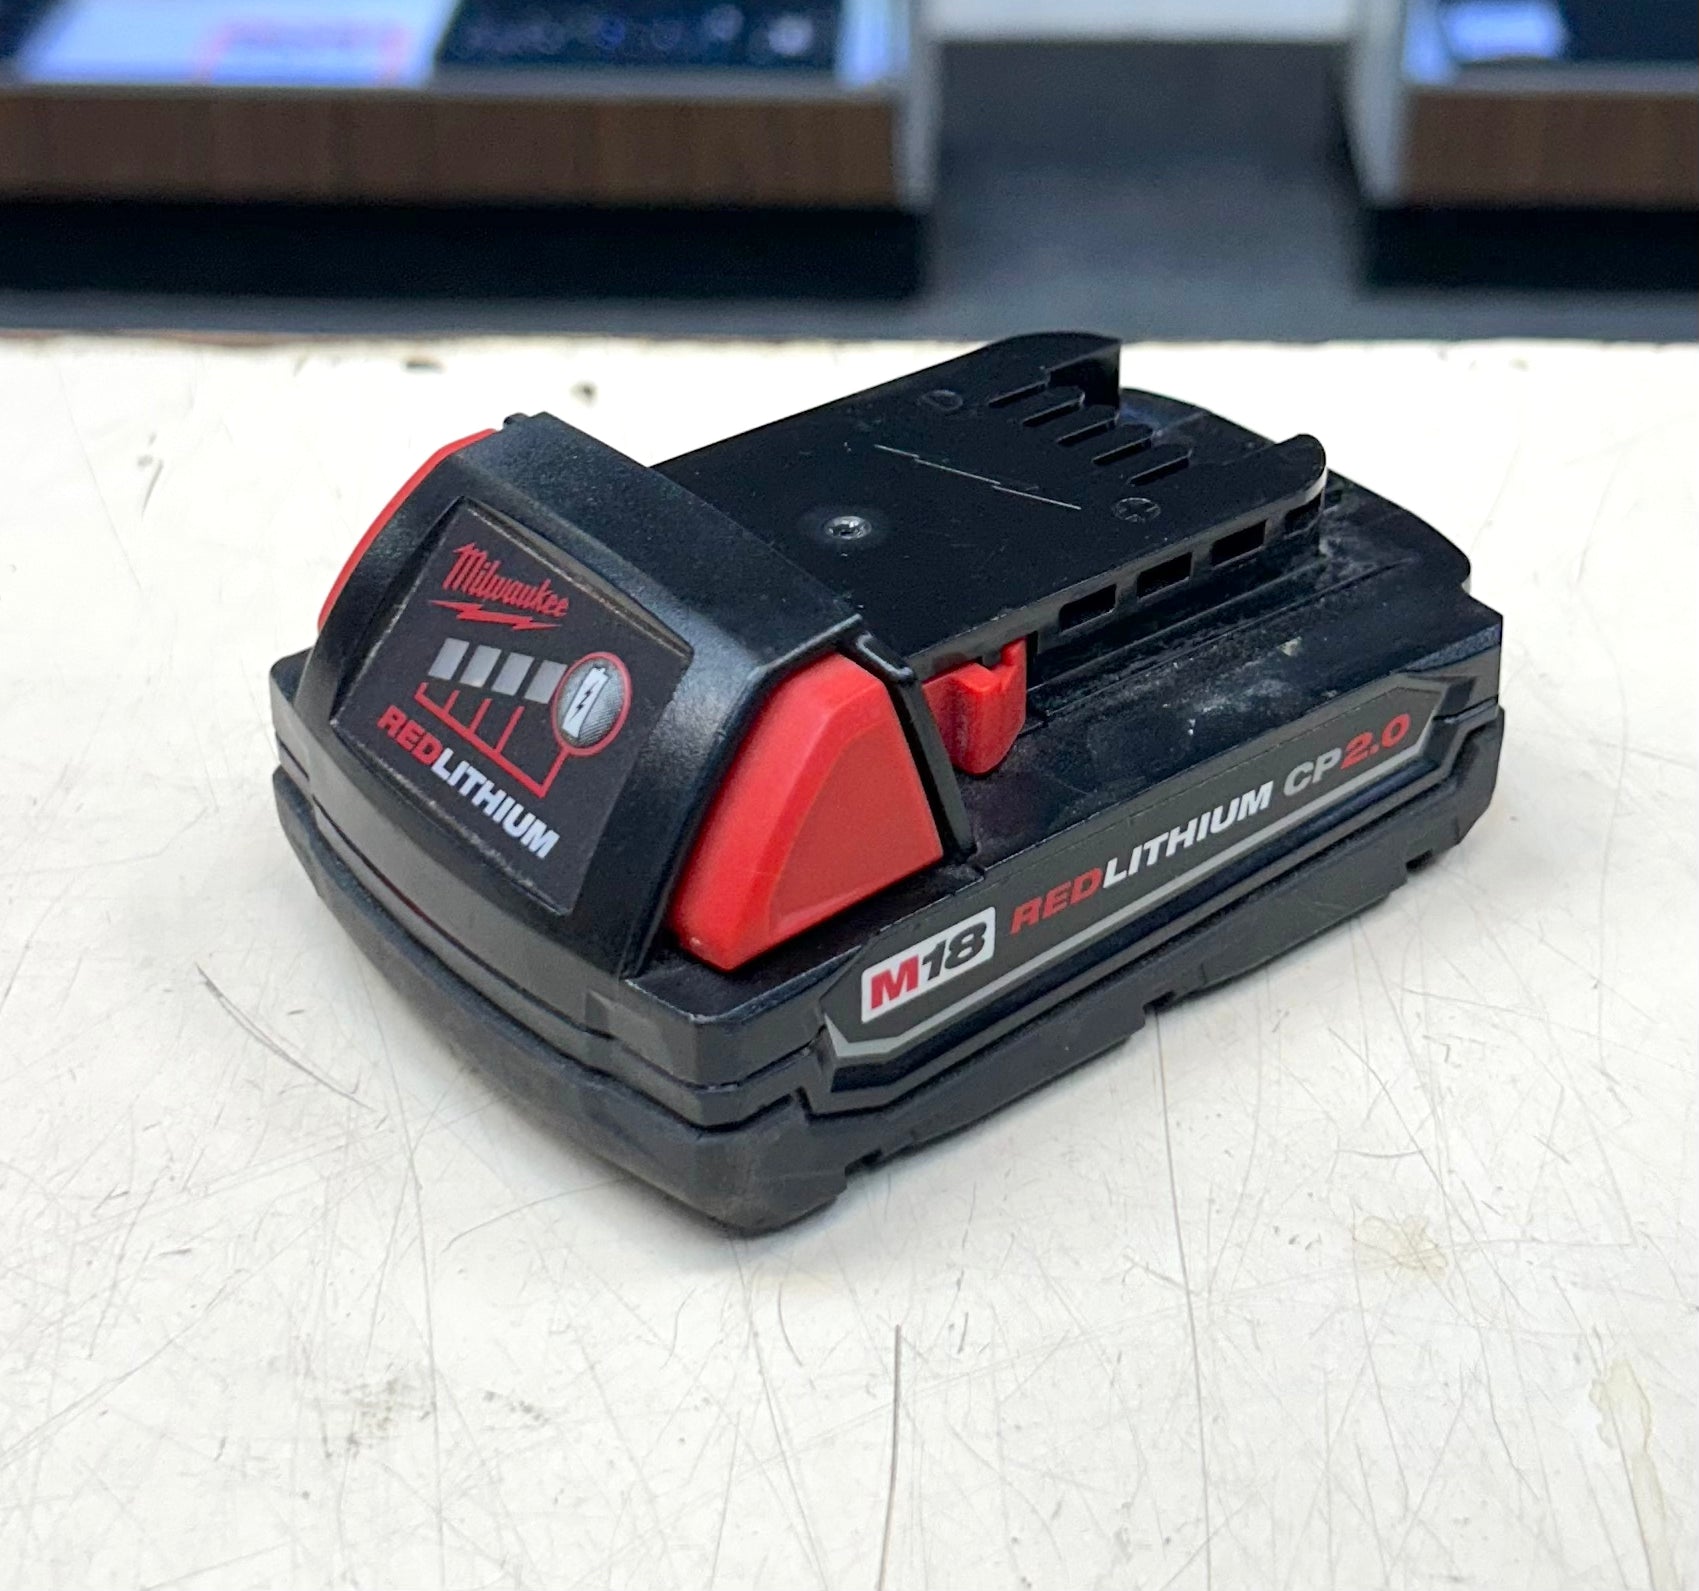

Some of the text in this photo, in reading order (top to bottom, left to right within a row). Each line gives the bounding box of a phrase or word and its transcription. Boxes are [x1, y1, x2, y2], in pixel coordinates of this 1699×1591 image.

[442, 543, 569, 617] Milwaukee
[377, 705, 560, 859] REDLITHIUM
[870, 714, 1411, 1009] M18 REDLITHIUM CP2.0
